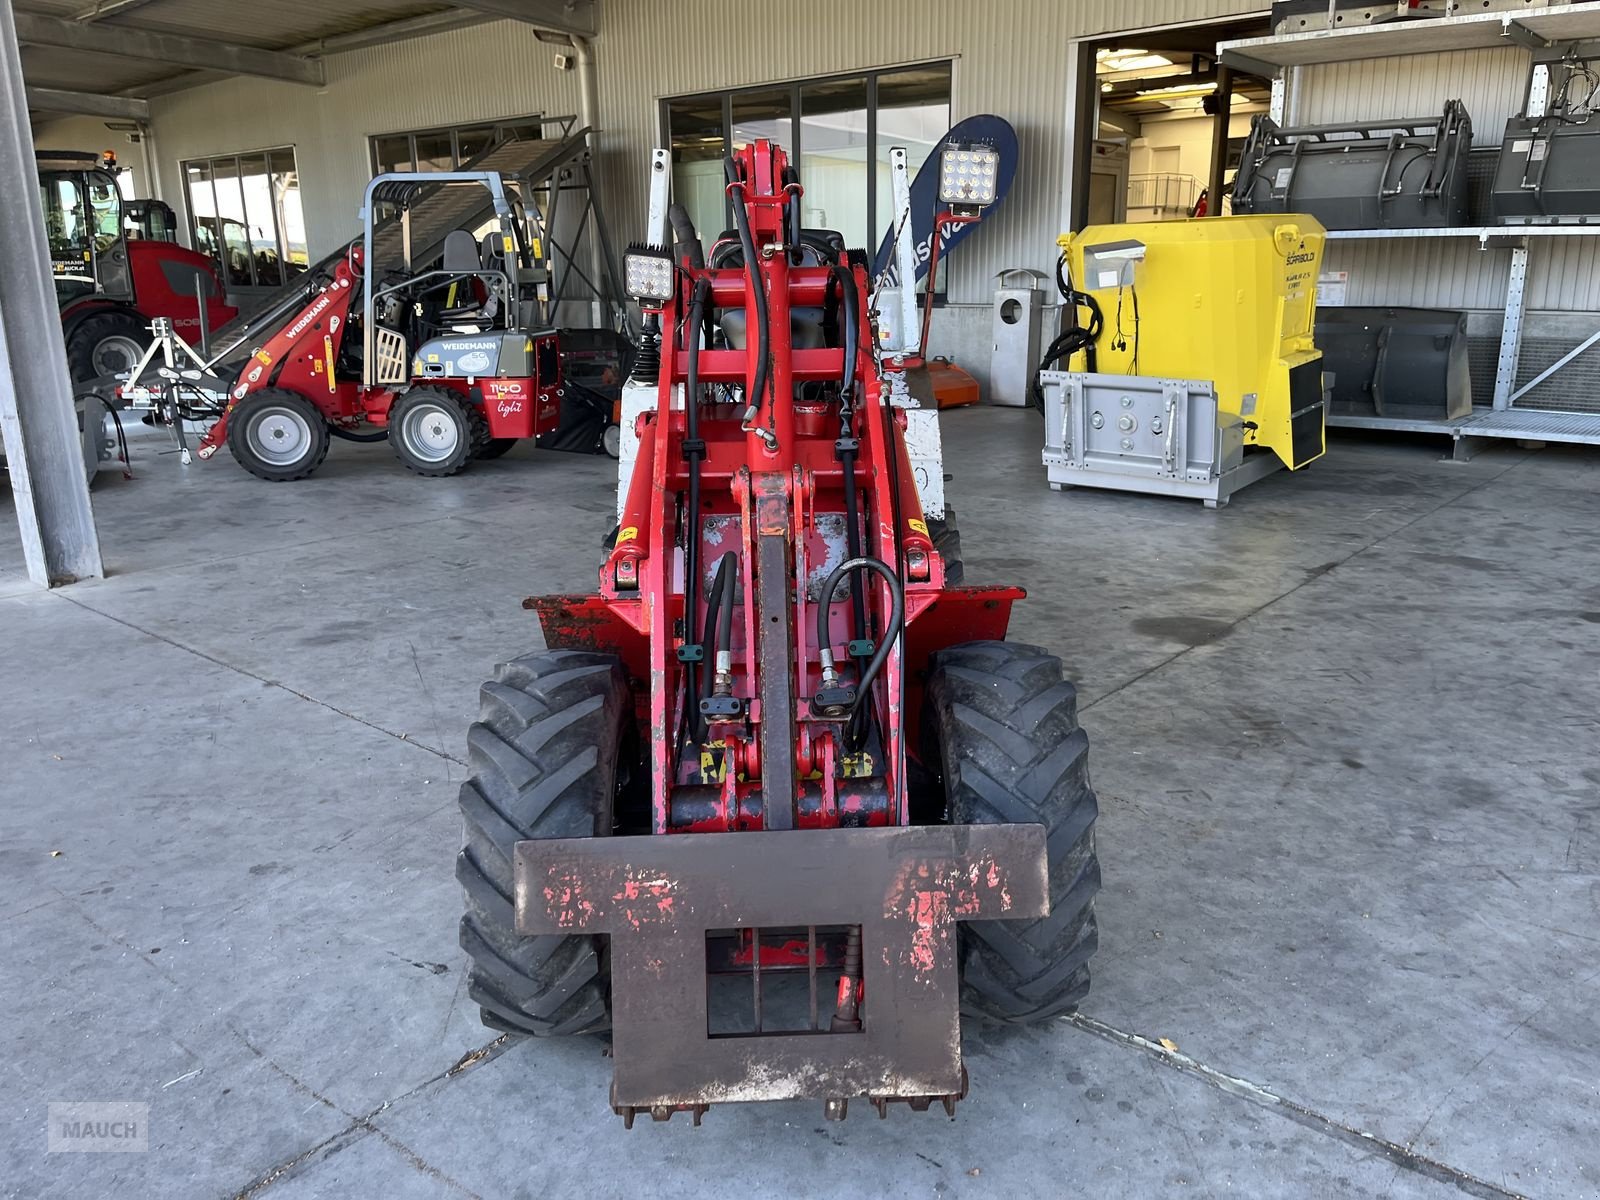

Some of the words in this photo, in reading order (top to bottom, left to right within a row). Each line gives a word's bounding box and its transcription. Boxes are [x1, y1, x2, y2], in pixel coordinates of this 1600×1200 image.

[175, 318, 202, 327] 508
[285, 296, 331, 339] WEIDEMANN
[442, 342, 496, 351] WEIDEMANN
[489, 384, 522, 394] 1140
[497, 400, 522, 418] light
